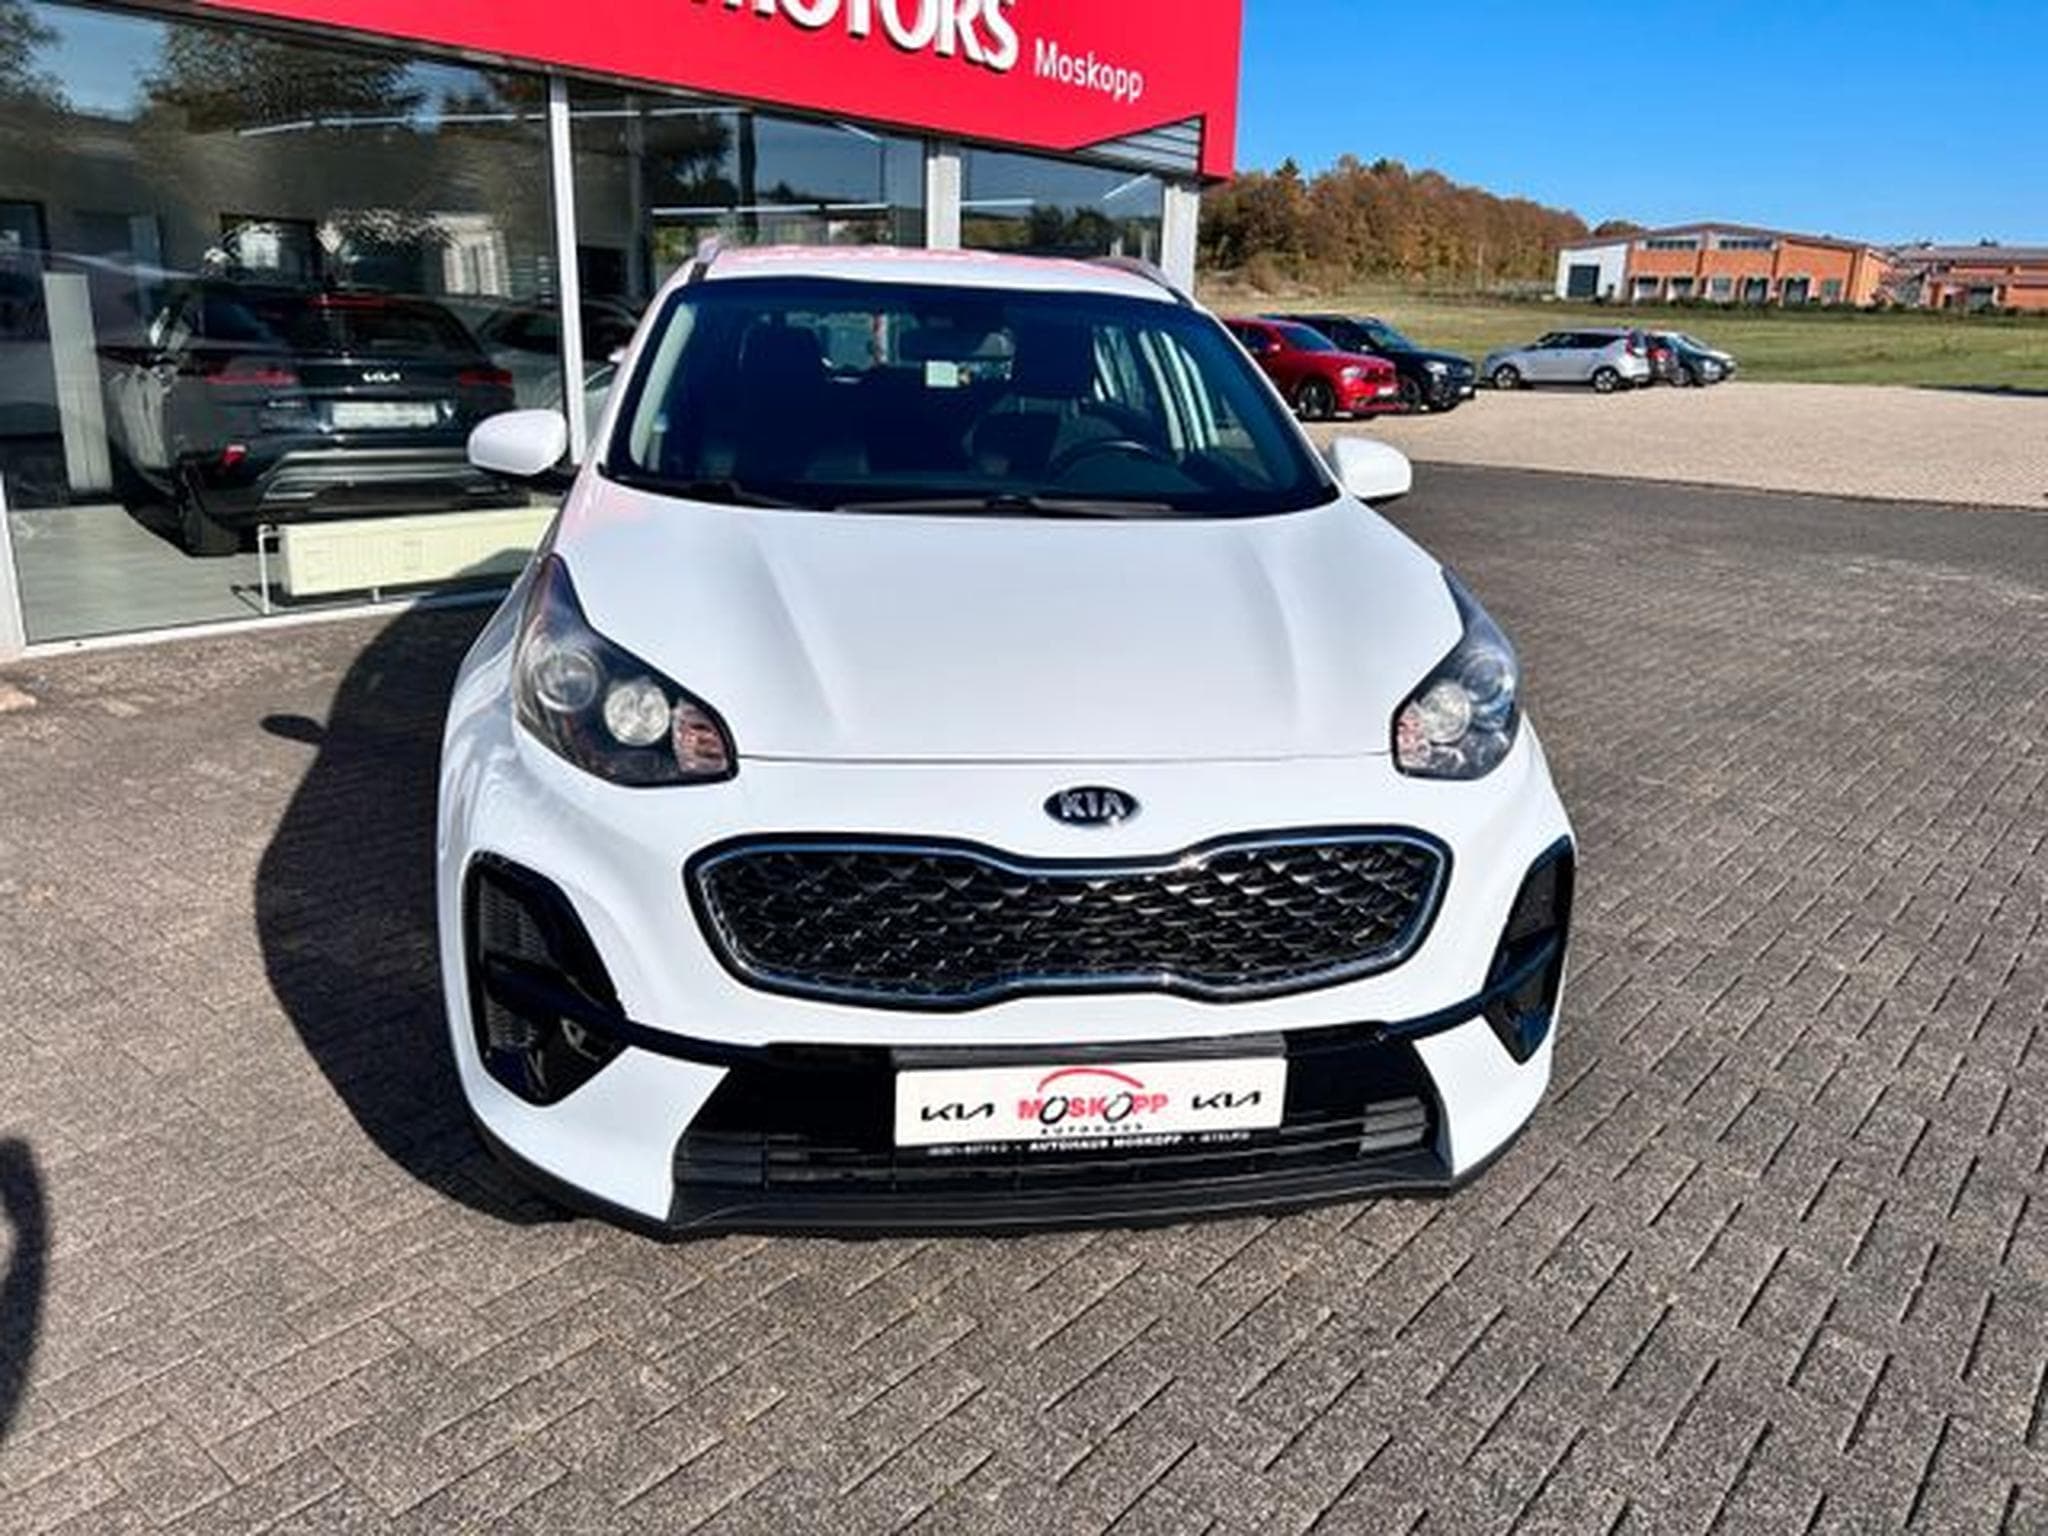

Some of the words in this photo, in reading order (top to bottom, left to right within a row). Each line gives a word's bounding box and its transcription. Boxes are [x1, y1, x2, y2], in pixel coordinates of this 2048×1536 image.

[692, 0, 1019, 71] ORS
[1034, 37, 1144, 103] Moskopp
[1059, 792, 1126, 817] KIA
[921, 1102, 994, 1121] KIA
[1018, 1092, 1169, 1125] MOSKOPP
[1191, 1090, 1261, 1110] KIA
